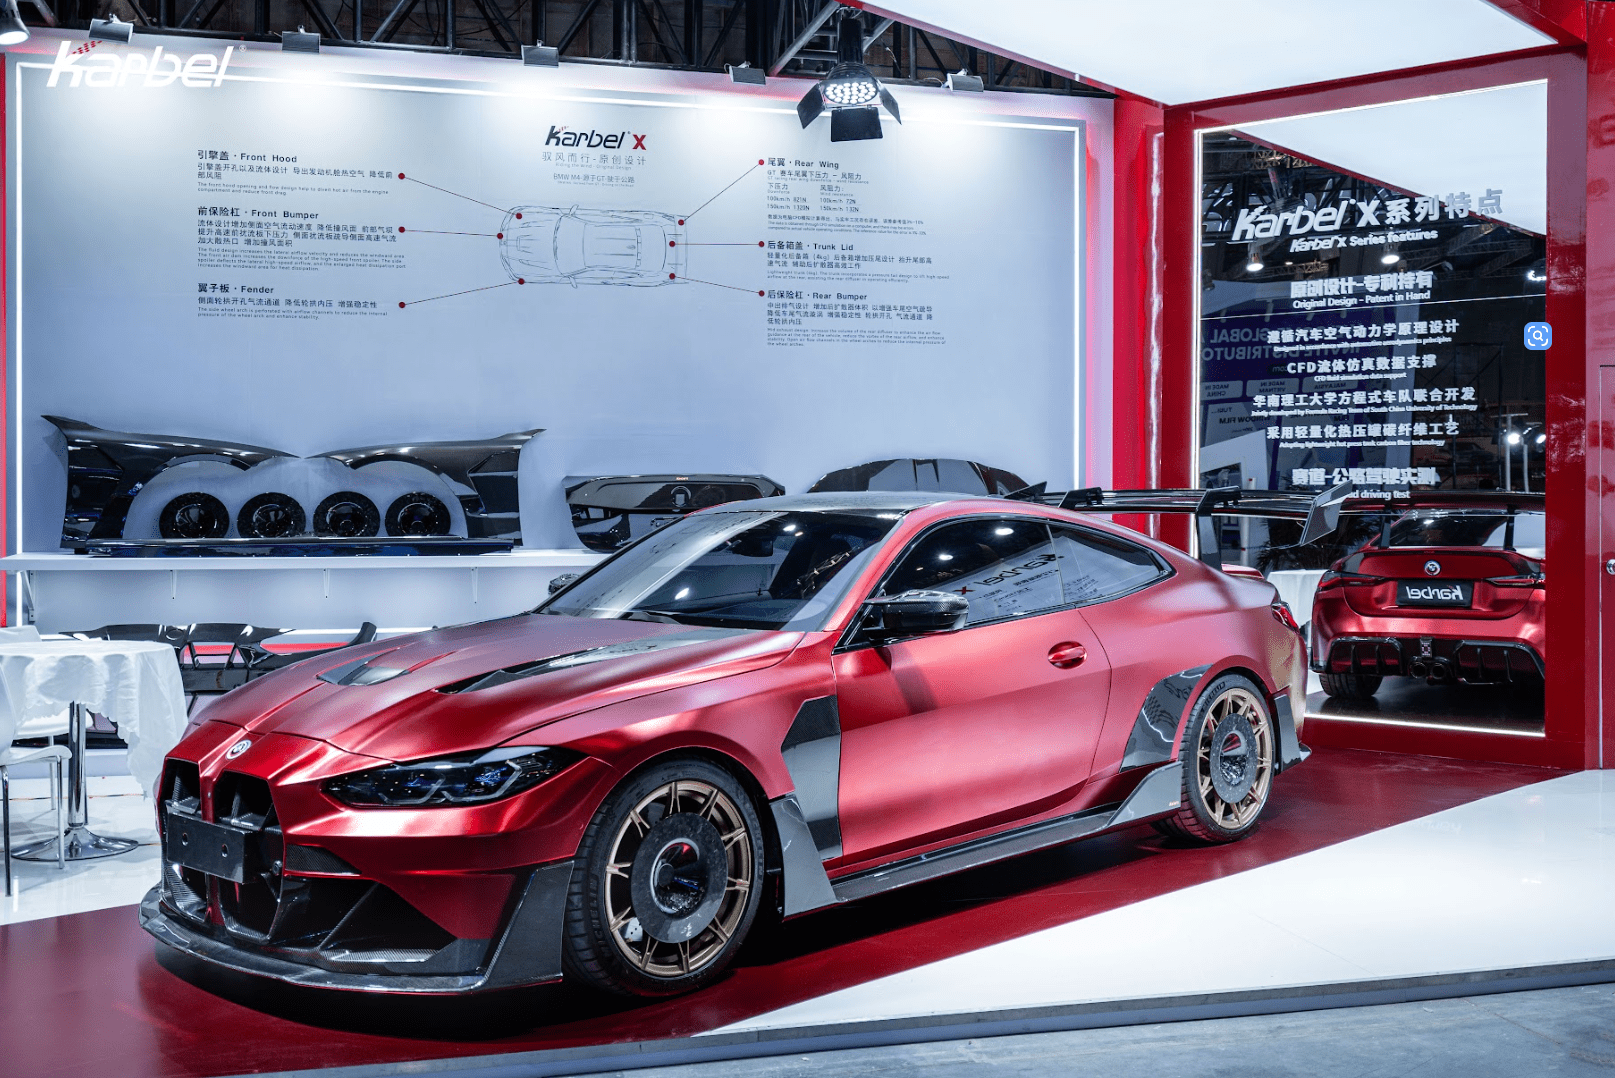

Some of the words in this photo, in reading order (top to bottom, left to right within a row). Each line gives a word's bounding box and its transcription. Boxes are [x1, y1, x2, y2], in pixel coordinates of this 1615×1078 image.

[198, 149, 229, 161] 引擎盖
[240, 153, 266, 162] Front
[272, 154, 297, 163] Hood
[767, 157, 785, 167] 尾翼
[795, 159, 813, 167] Rear
[819, 161, 839, 170] Wing
[841, 172, 862, 180] 风阻力
[768, 182, 788, 190] 下压力
[198, 206, 240, 216] 前保险杠
[251, 209, 277, 217] Front
[283, 211, 319, 220] Bumper
[768, 240, 803, 250] 后备箱盖
[1350, 234, 1385, 247] Series
[1387, 230, 1438, 244] features
[198, 283, 230, 293] 翼子板
[241, 285, 274, 294] Fender
[768, 289, 803, 299] 后保险杠
[837, 293, 867, 301] Bumper
[1292, 298, 1326, 310] Original
[1328, 297, 1357, 307] Design
[1365, 293, 1394, 304] Patent
[1395, 292, 1404, 301] in
[1406, 290, 1430, 300] Hand
[1267, 319, 1459, 344] 遵循汽车空气动力学原理设计
[1287, 354, 1437, 374] CFD流体仿真数据支撑
[1253, 386, 1475, 408] 华南理工大学方程式车队联合开发
[1267, 422, 1459, 439] 采用轻量化热压罐碳纤维工艺
[1361, 489, 1392, 501] driving
[1393, 490, 1411, 499] test
